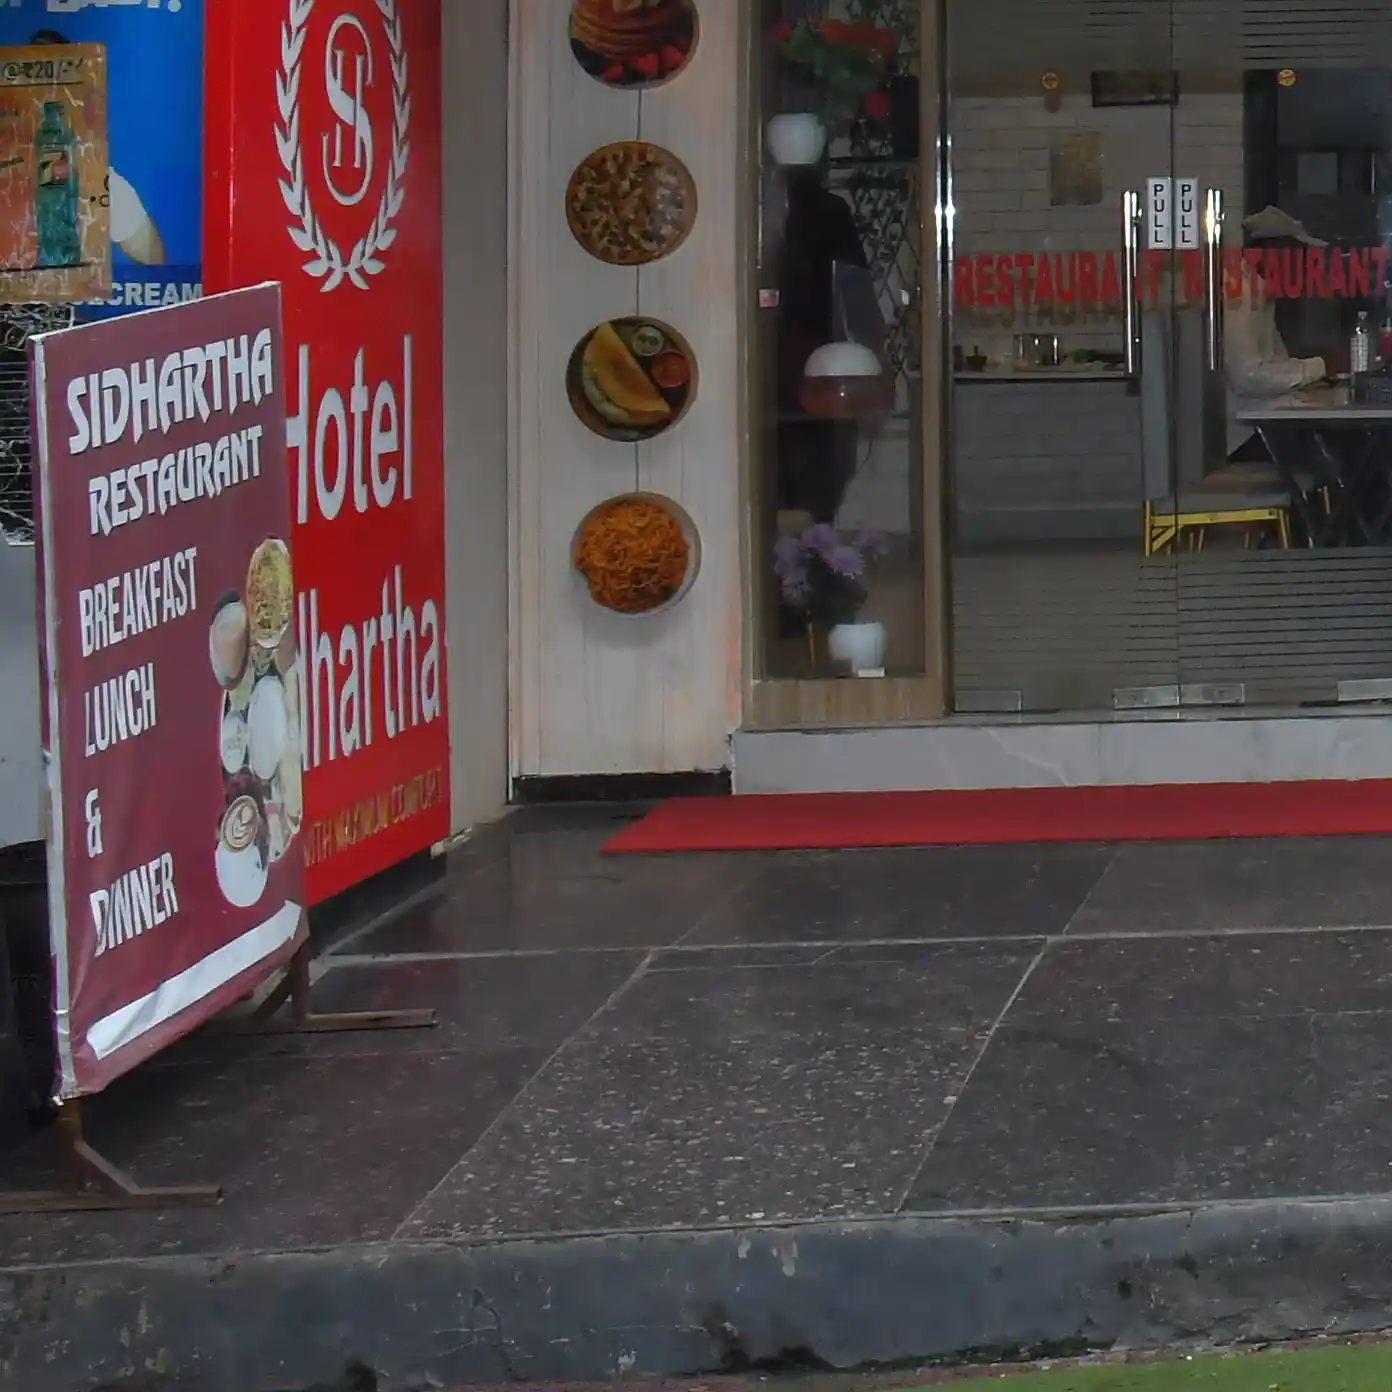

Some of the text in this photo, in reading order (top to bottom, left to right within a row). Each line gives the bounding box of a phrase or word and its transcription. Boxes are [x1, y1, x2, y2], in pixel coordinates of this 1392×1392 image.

[1153, 184, 1165, 244] PULL
[1181, 184, 1192, 244] PULL
[1182, 246, 1390, 301] RSTAURANT
[67, 328, 273, 455] SIDHARTHA
[286, 333, 413, 525] Hotel
[89, 425, 264, 536] RESTAURANT
[79, 547, 198, 659] BREAKFAST
[84, 663, 157, 758] LUNCH
[85, 788, 103, 859] &
[89, 852, 179, 958] DINNER
